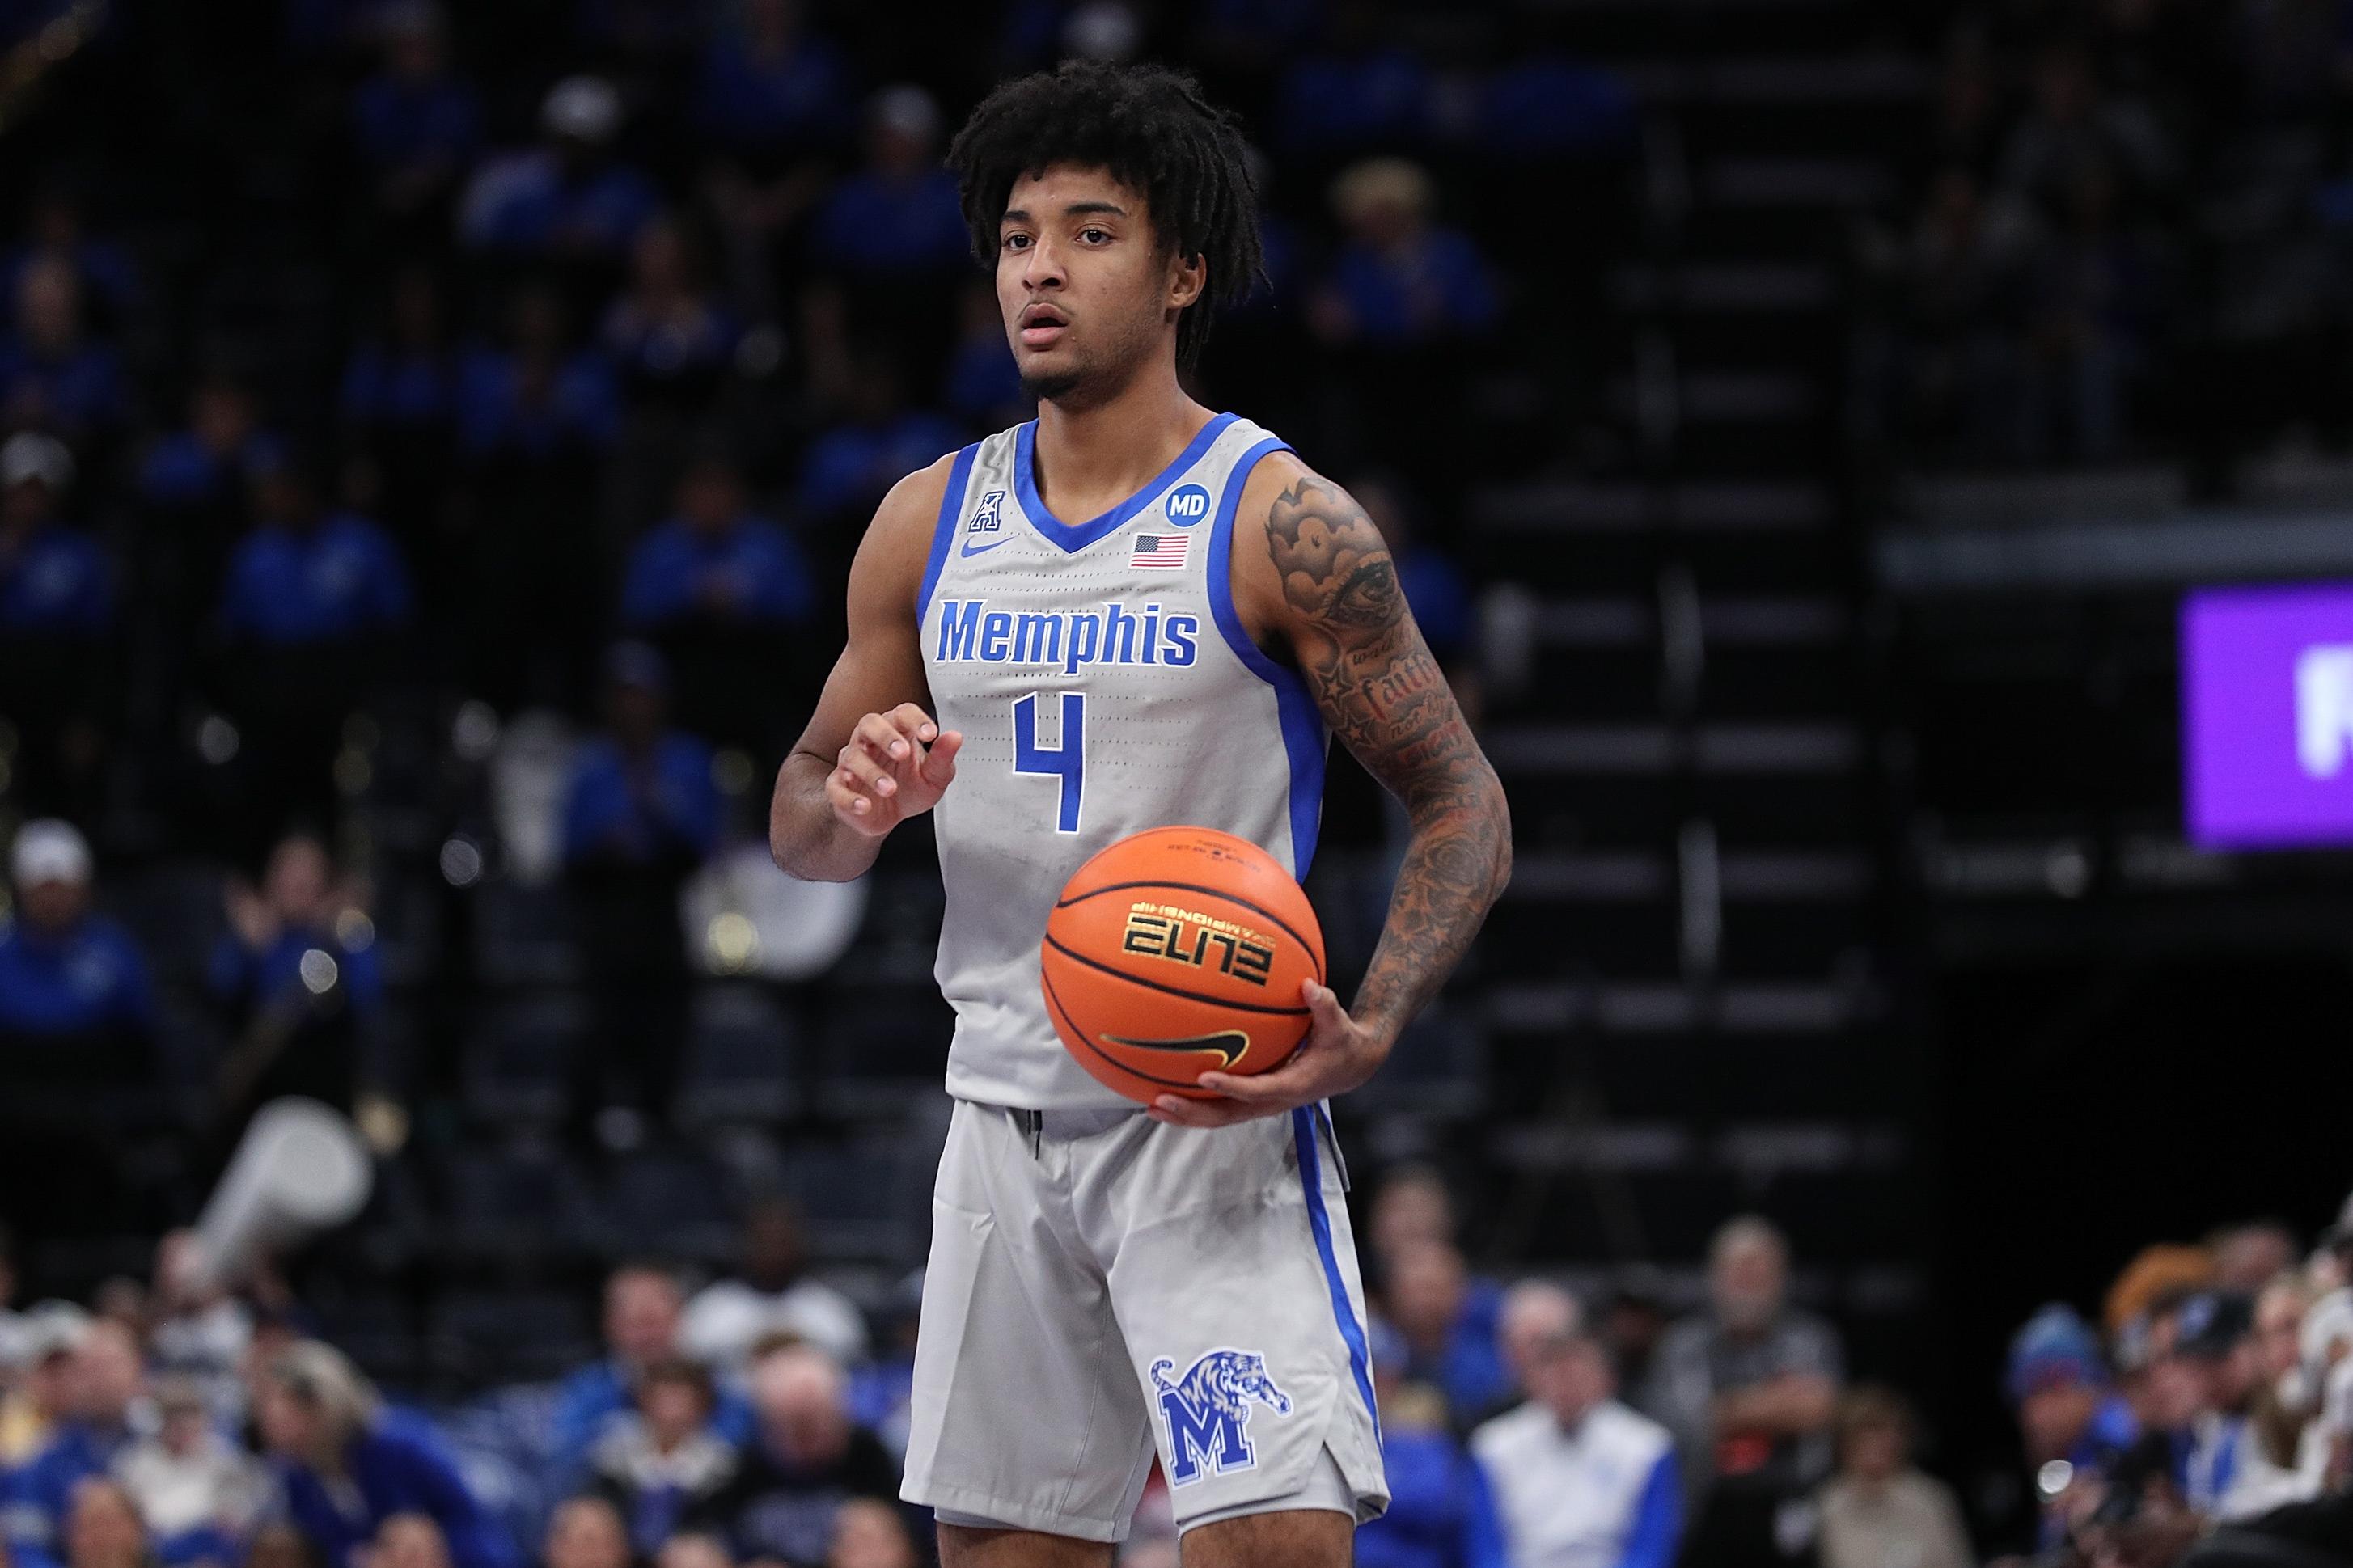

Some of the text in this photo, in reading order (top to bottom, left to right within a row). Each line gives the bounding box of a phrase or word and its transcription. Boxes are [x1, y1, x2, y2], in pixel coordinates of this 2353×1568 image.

[1170, 494, 1205, 516] MD
[933, 599, 1200, 677] Memphis
[1011, 691, 1086, 835] 4
[1123, 912, 1273, 987] ELITE
[1157, 1386, 1257, 1488] M
